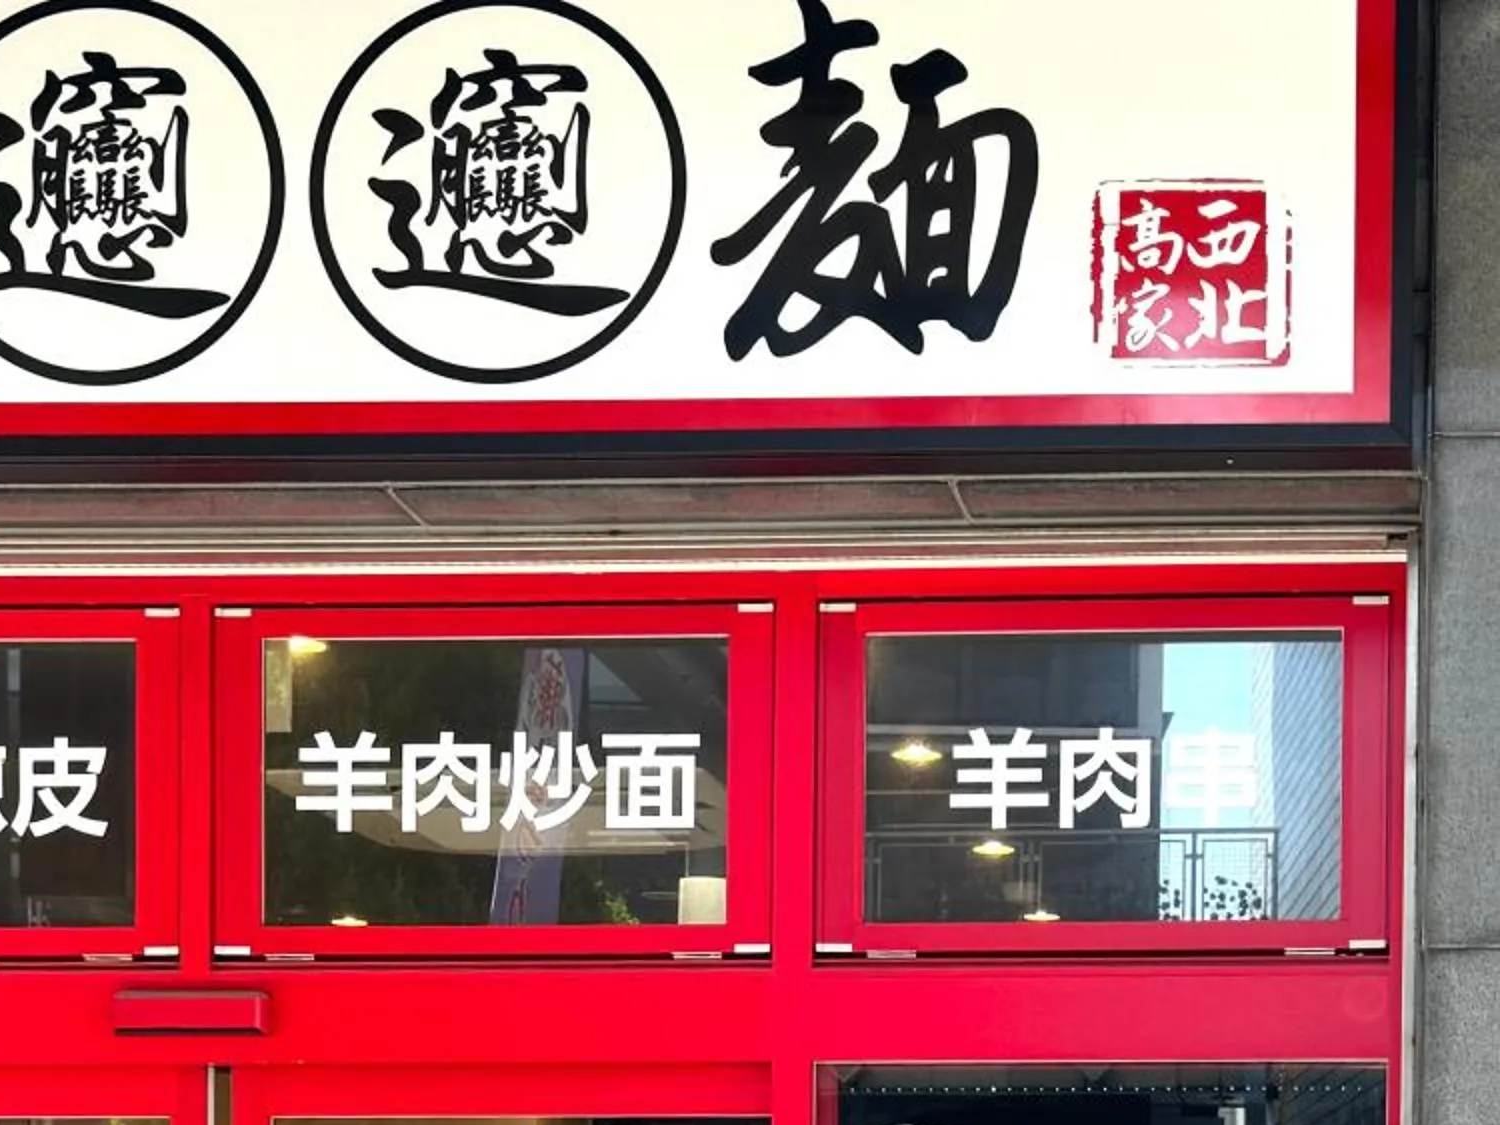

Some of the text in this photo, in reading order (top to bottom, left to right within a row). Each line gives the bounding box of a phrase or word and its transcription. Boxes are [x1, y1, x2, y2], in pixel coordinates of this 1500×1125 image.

[295, 731, 701, 832] 羊肉炒面
[949, 726, 1257, 829] 羊肉串
